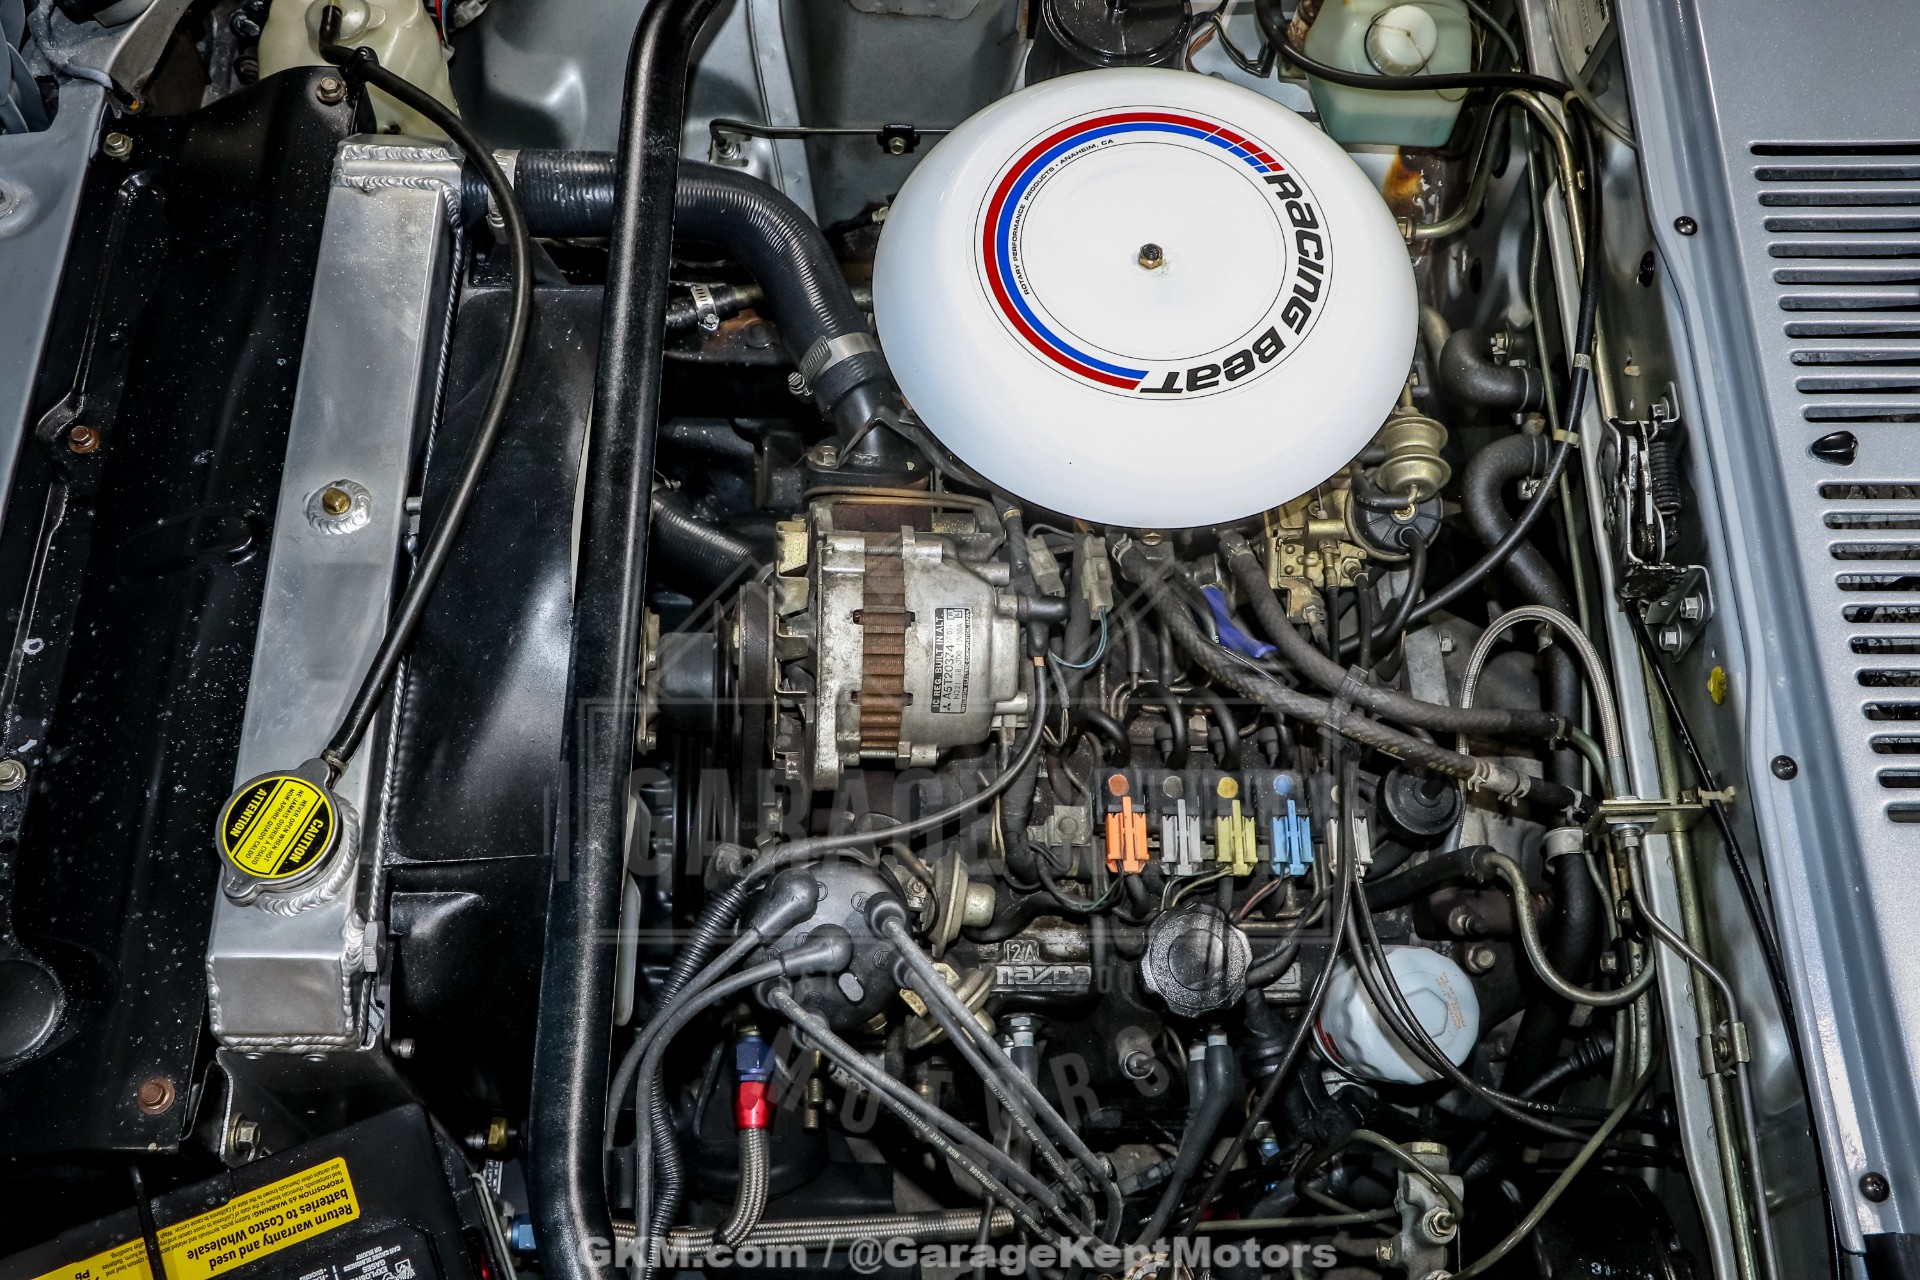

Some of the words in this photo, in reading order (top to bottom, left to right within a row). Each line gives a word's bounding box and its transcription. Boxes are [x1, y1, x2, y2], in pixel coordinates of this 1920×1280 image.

[1060, 143, 1099, 165] ANAHEIM,
[1024, 166, 1055, 201] PRODUCTS
[1011, 203, 1025, 262] PERFORMANCE
[1014, 264, 1030, 295] ROTARY
[936, 635, 943, 644] IN
[935, 648, 943, 673] BUILT
[943, 644, 955, 699] A5T20374
[933, 676, 942, 696] REG.
[933, 699, 939, 707] IC
[283, 787, 294, 800] NON
[295, 789, 303, 798] NE
[228, 787, 268, 838] ATTENTION
[270, 800, 286, 820] APRIRE
[281, 797, 298, 819] JAMAIS
[292, 799, 307, 818] NEVER
[267, 818, 284, 840] OUVRIR
[282, 817, 295, 833] OPEN
[244, 839, 260, 859] CALDO
[271, 832, 285, 850] WHEN
[288, 817, 324, 863] CAUTION
[250, 845, 267, 865] CHAUD
[262, 849, 274, 862] HOT
[893, 1100, 930, 1132] PROTECTION
[928, 1130, 946, 1147] HEAT
[945, 1144, 960, 1159] HIGH
[332, 1170, 342, 1179] lead
[298, 1178, 344, 1200] PROPOSITION
[251, 1200, 287, 1218] WARNING:
[288, 1196, 297, 1204] 65
[299, 1188, 348, 1217] batteries
[212, 1214, 235, 1228] California
[249, 1214, 285, 1236] Costco
[286, 1209, 298, 1223] to
[315, 1203, 353, 1227] Return
[261, 1219, 313, 1247] warranty
[187, 1229, 247, 1262] Wholesale
[239, 1240, 261, 1259] and
[209, 1250, 237, 1271] used
[361, 1258, 386, 1273] GASES
[74, 1269, 90, 1280] Pb
